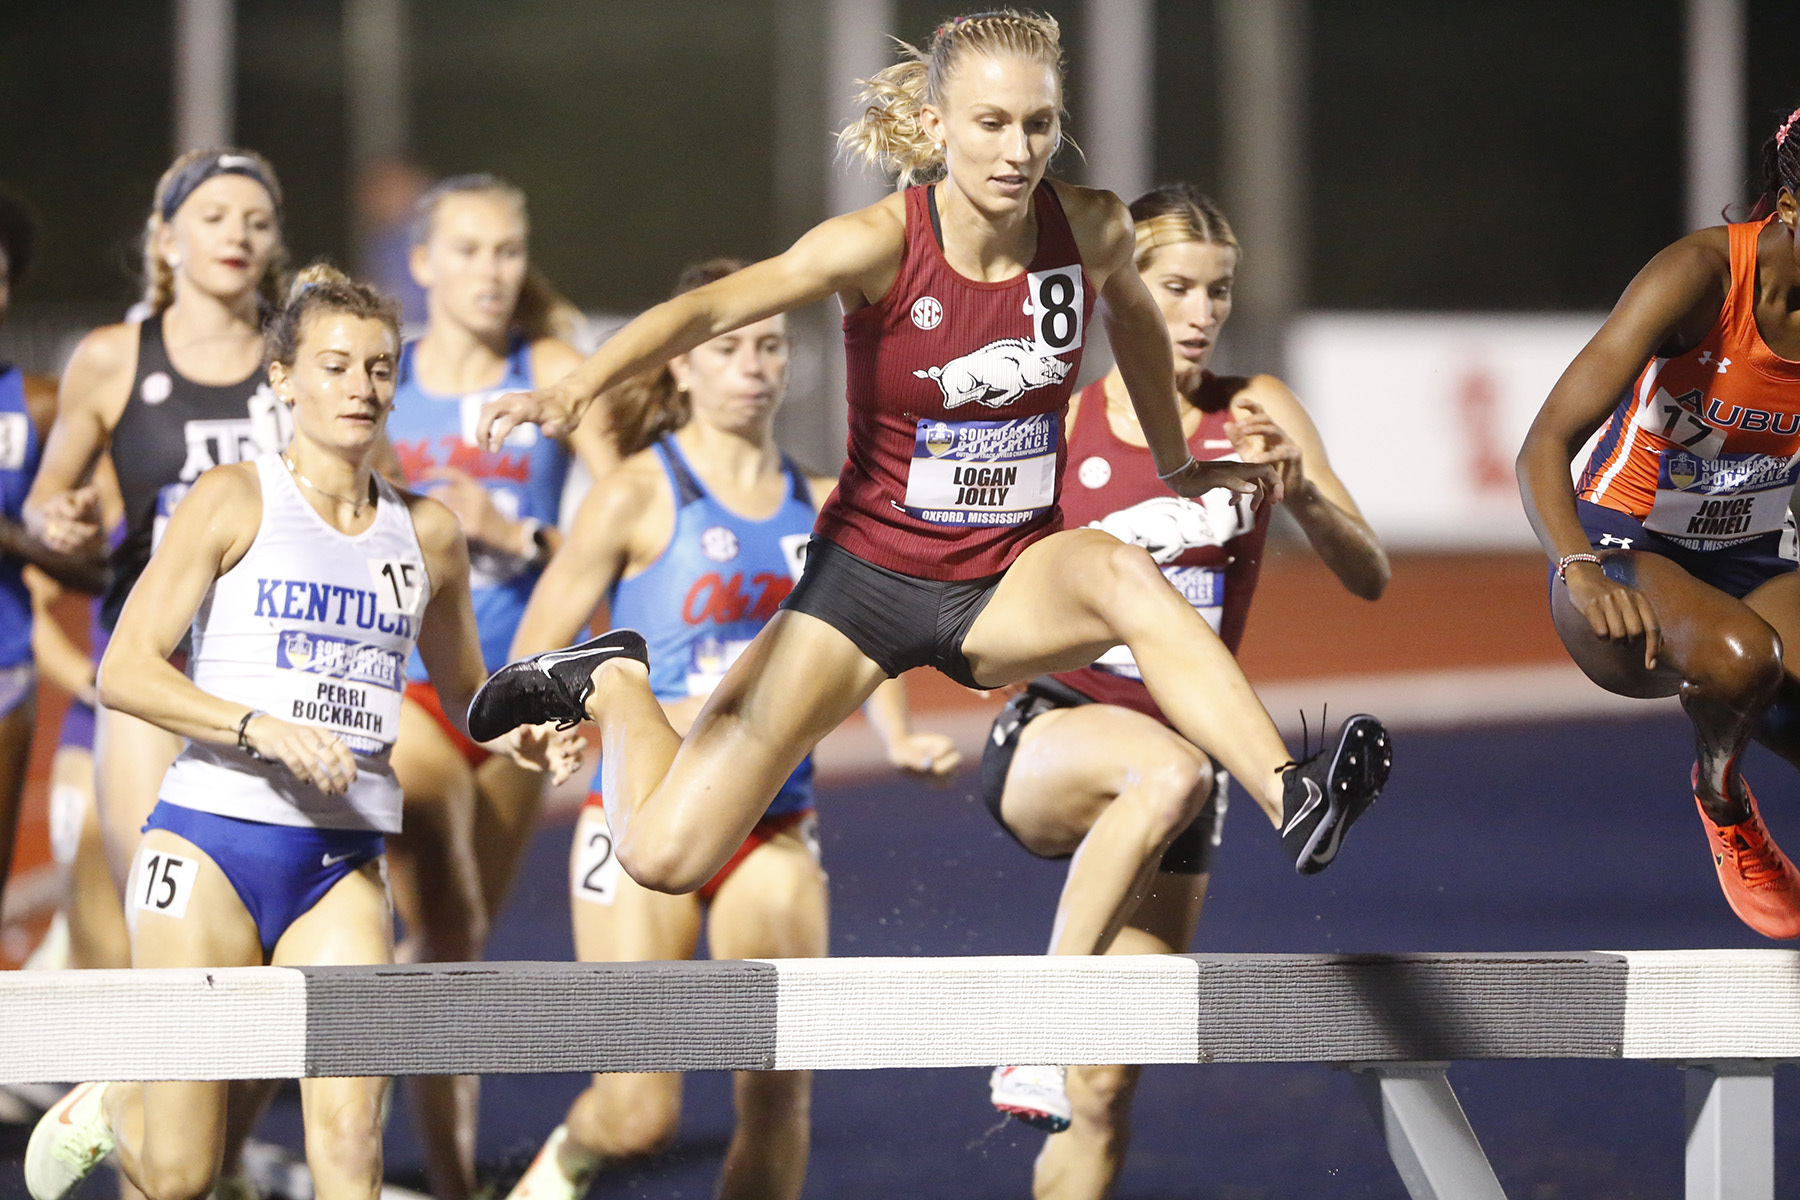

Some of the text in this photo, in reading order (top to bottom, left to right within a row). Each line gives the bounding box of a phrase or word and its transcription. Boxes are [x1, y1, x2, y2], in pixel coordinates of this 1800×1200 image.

[912, 296, 942, 329] SEC
[1039, 273, 1078, 349] 8
[958, 419, 1050, 442] SOUTHEASTERN
[1662, 404, 1713, 448] 17
[957, 432, 1049, 454] CONFERENCE
[953, 466, 1018, 487] LOGAN
[954, 486, 1010, 506] JOLLY
[1696, 497, 1755, 517] JOYCE
[921, 510, 1034, 524] OXFORD, MISSISSIPPI
[1686, 515, 1752, 536] KIMELI
[317, 682, 366, 708] PERRI
[292, 699, 383, 734] BOCKRATH
[582, 832, 612, 894] 2
[147, 854, 184, 910] 15
